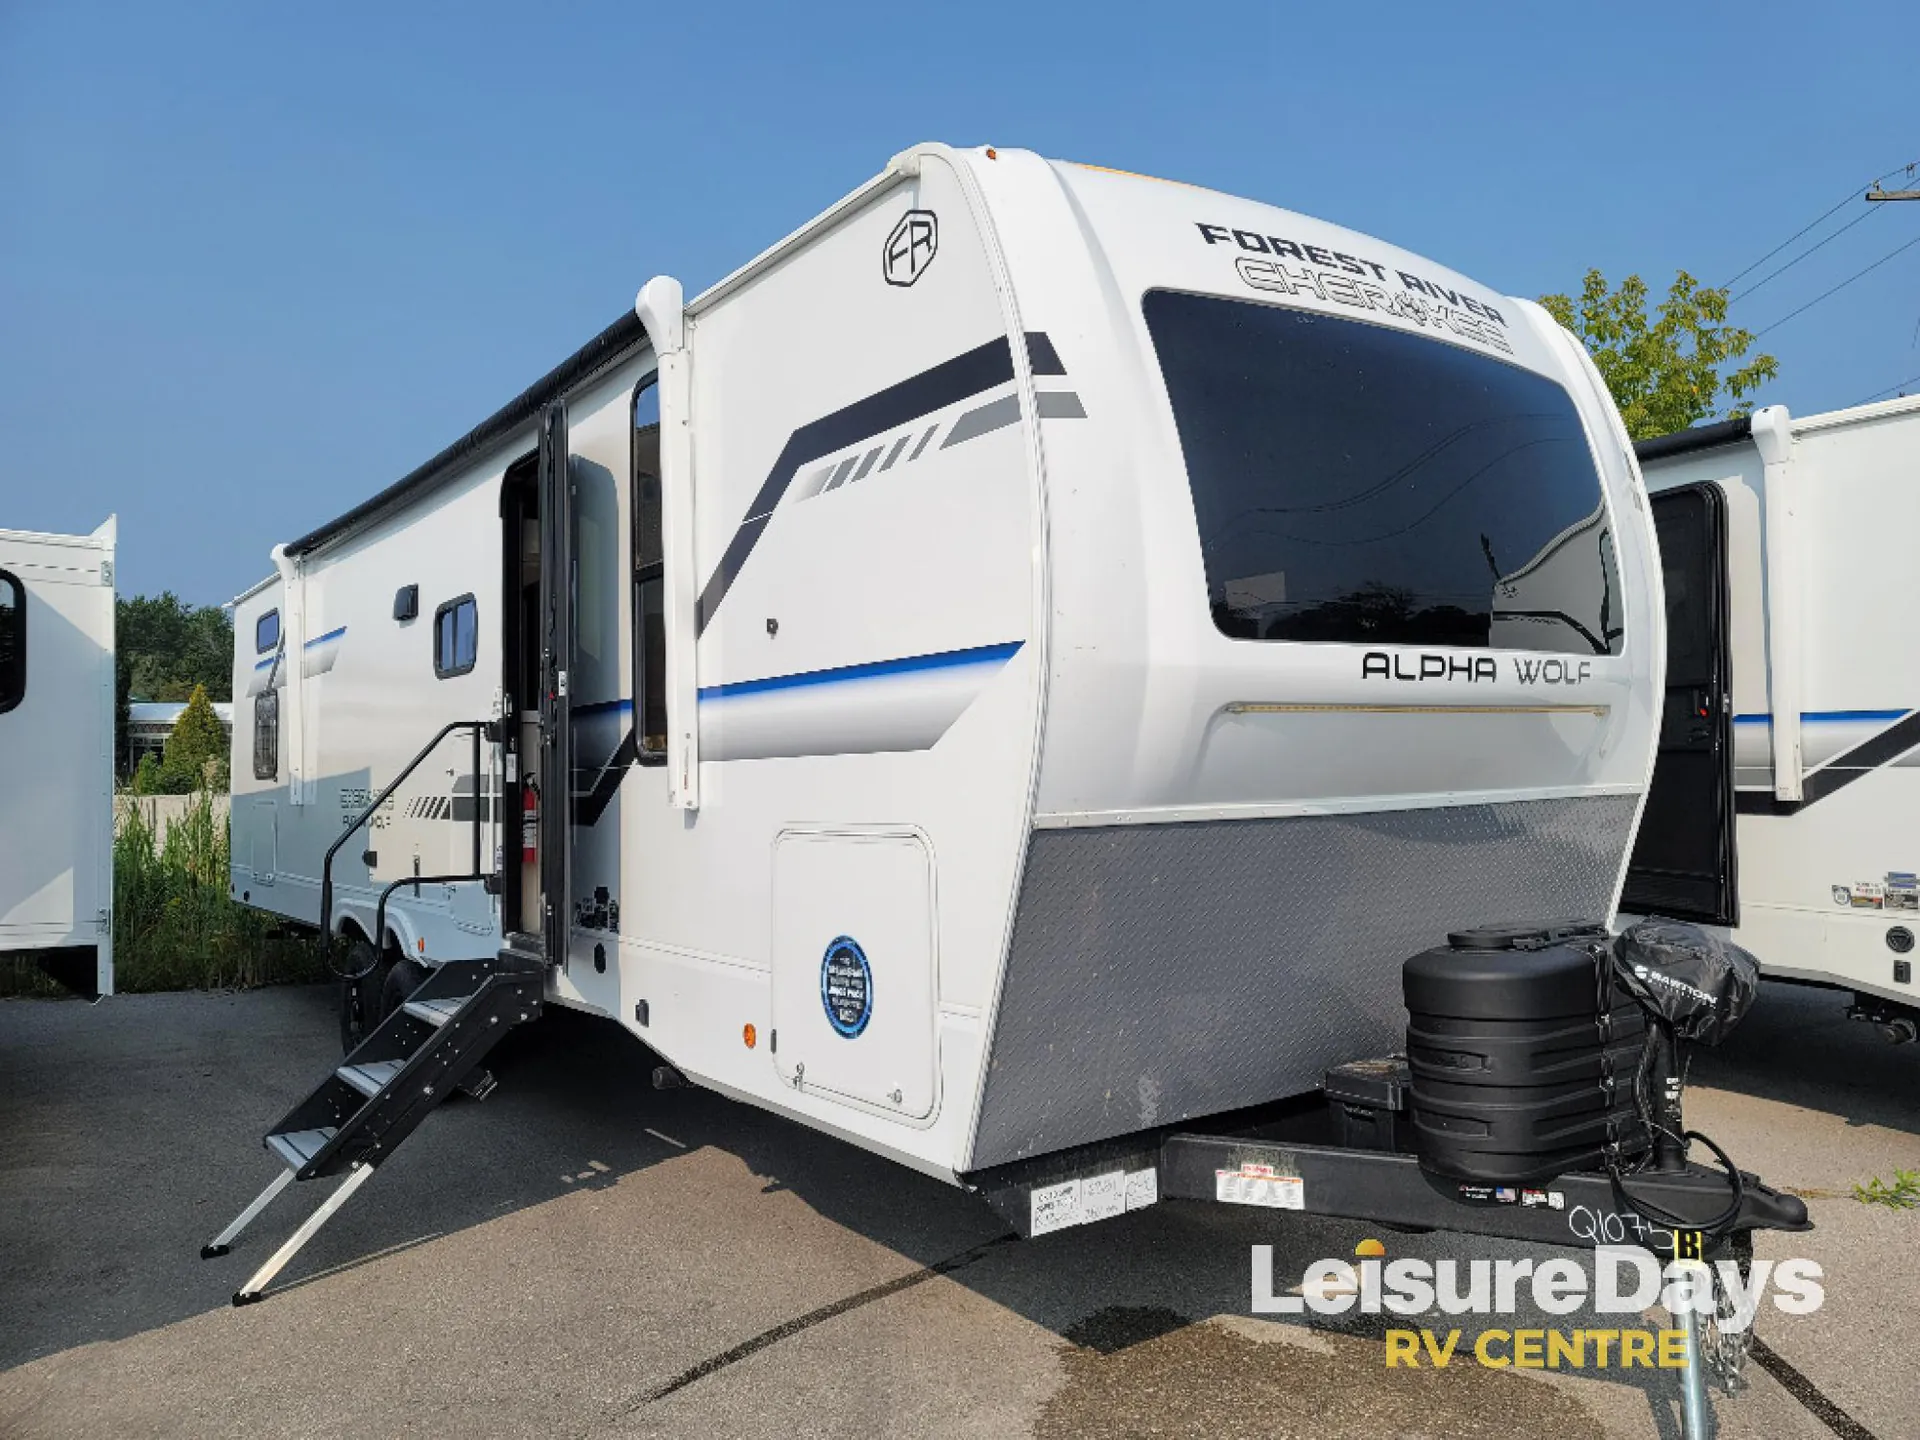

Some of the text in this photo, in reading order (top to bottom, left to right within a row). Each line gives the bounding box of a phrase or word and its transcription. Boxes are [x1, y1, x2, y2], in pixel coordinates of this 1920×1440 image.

[1194, 221, 1508, 328] FOREST RIVER
[1362, 651, 1591, 685] ALPHA WOLF
